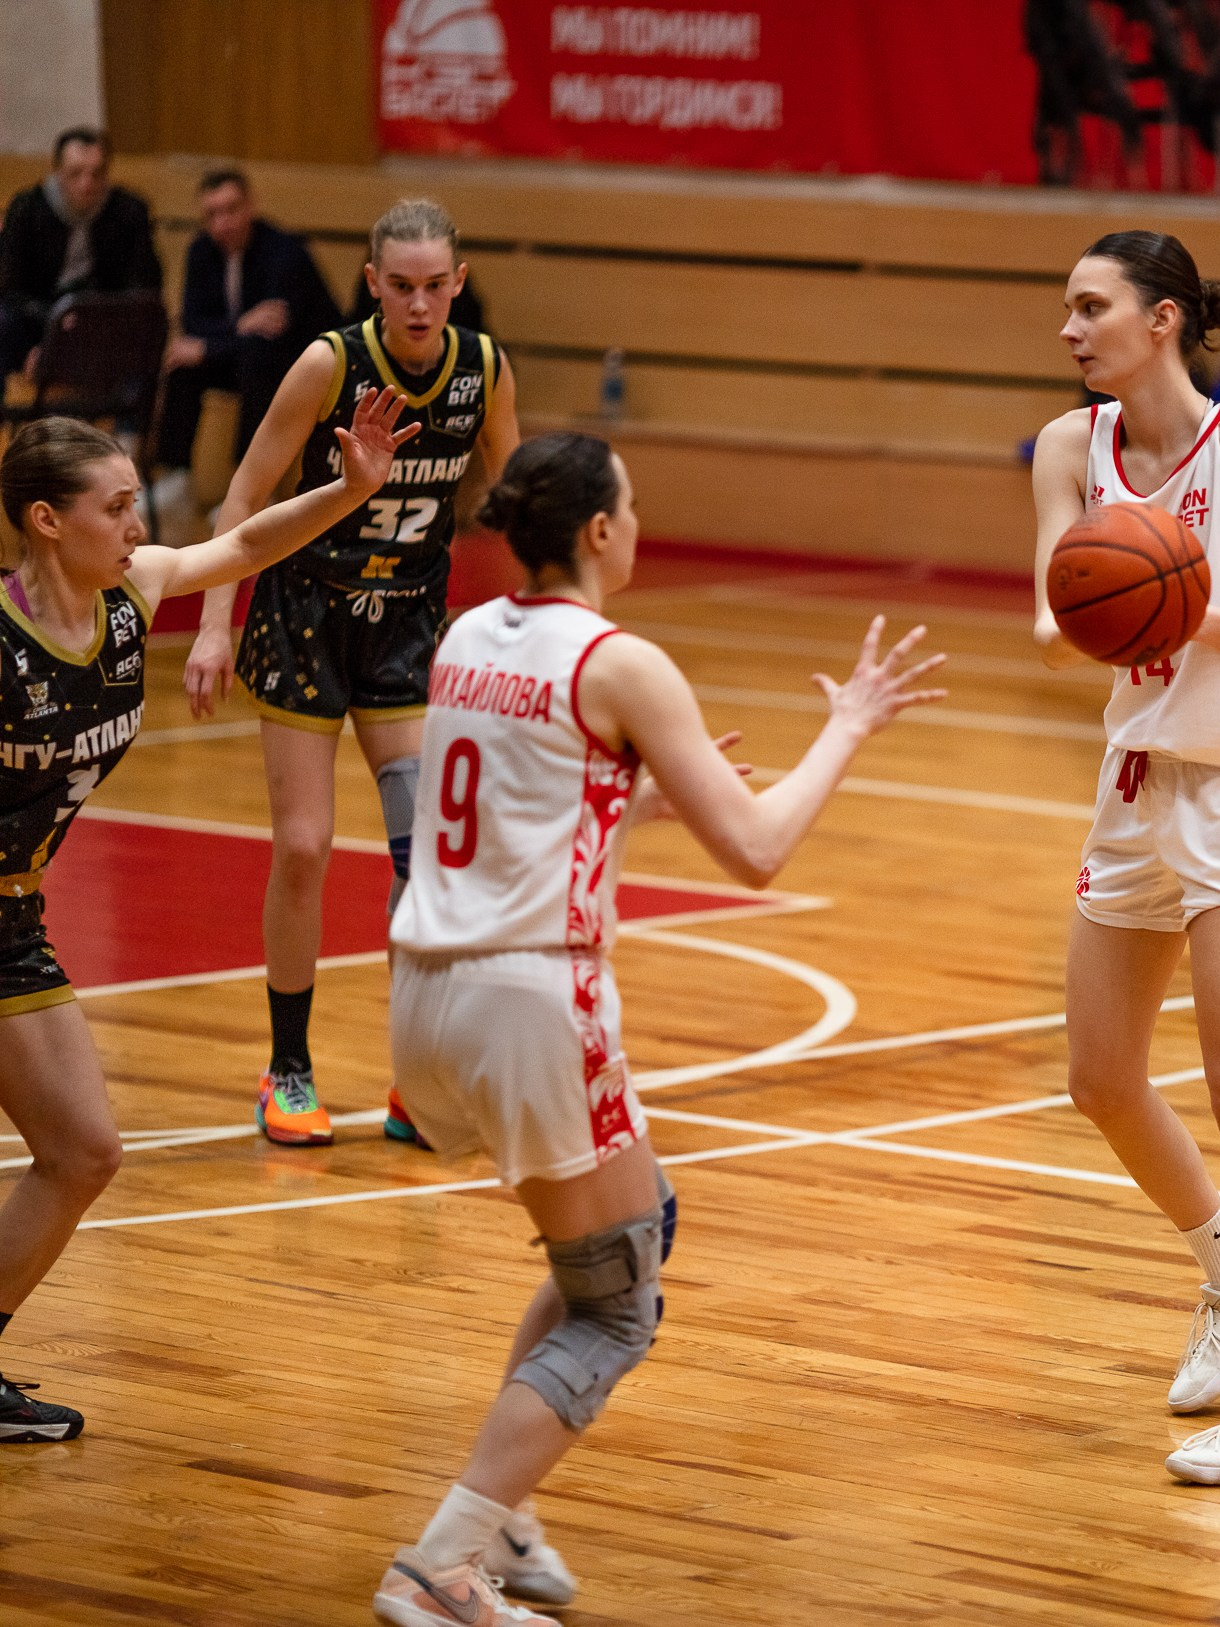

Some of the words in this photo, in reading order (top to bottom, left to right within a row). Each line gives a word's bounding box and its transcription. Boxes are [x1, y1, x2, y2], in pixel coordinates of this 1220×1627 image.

[450, 374, 483, 391] FON
[447, 388, 479, 406] BET
[1180, 488, 1206, 510] ON
[359, 497, 440, 543] 32
[110, 600, 136, 630] FON
[437, 738, 481, 868] 9
